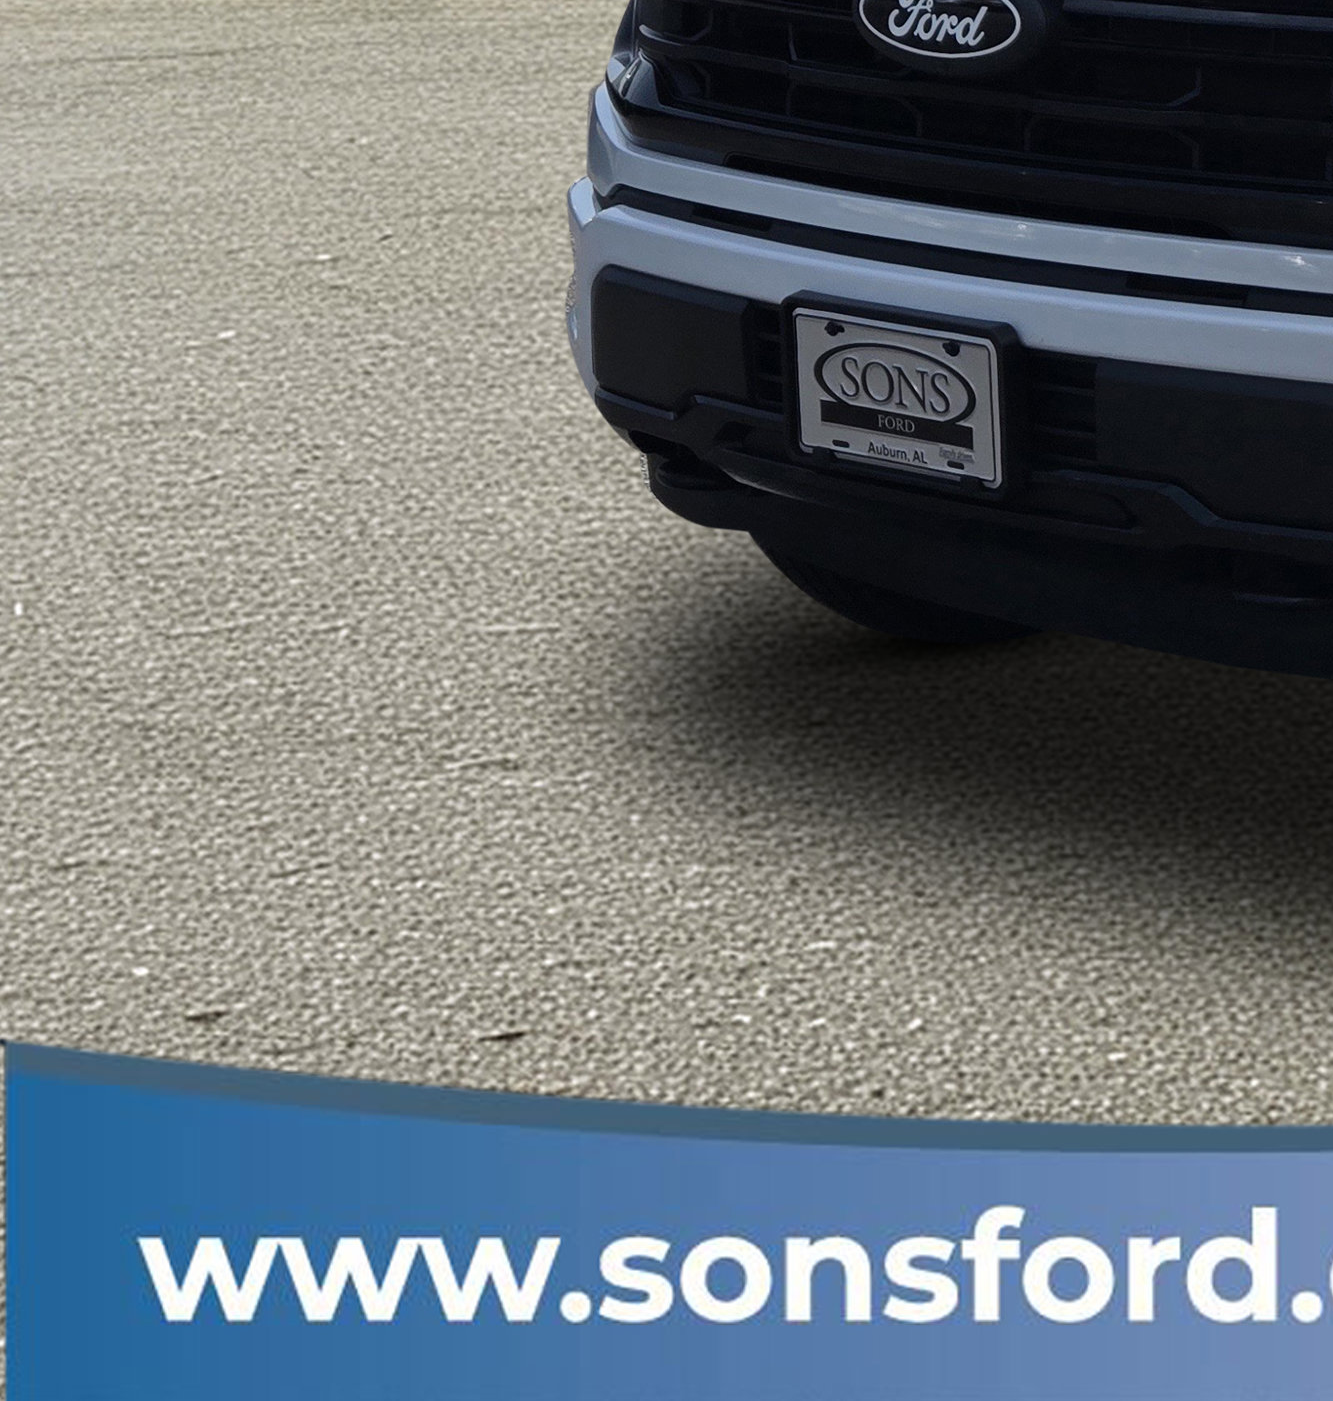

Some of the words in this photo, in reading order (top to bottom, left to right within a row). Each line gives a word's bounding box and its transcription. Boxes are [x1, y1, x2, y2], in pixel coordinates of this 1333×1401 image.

[839, 356, 951, 414] SONS
[877, 414, 916, 433] FORD
[867, 441, 911, 463] Auburn,
[912, 450, 929, 465] AL
